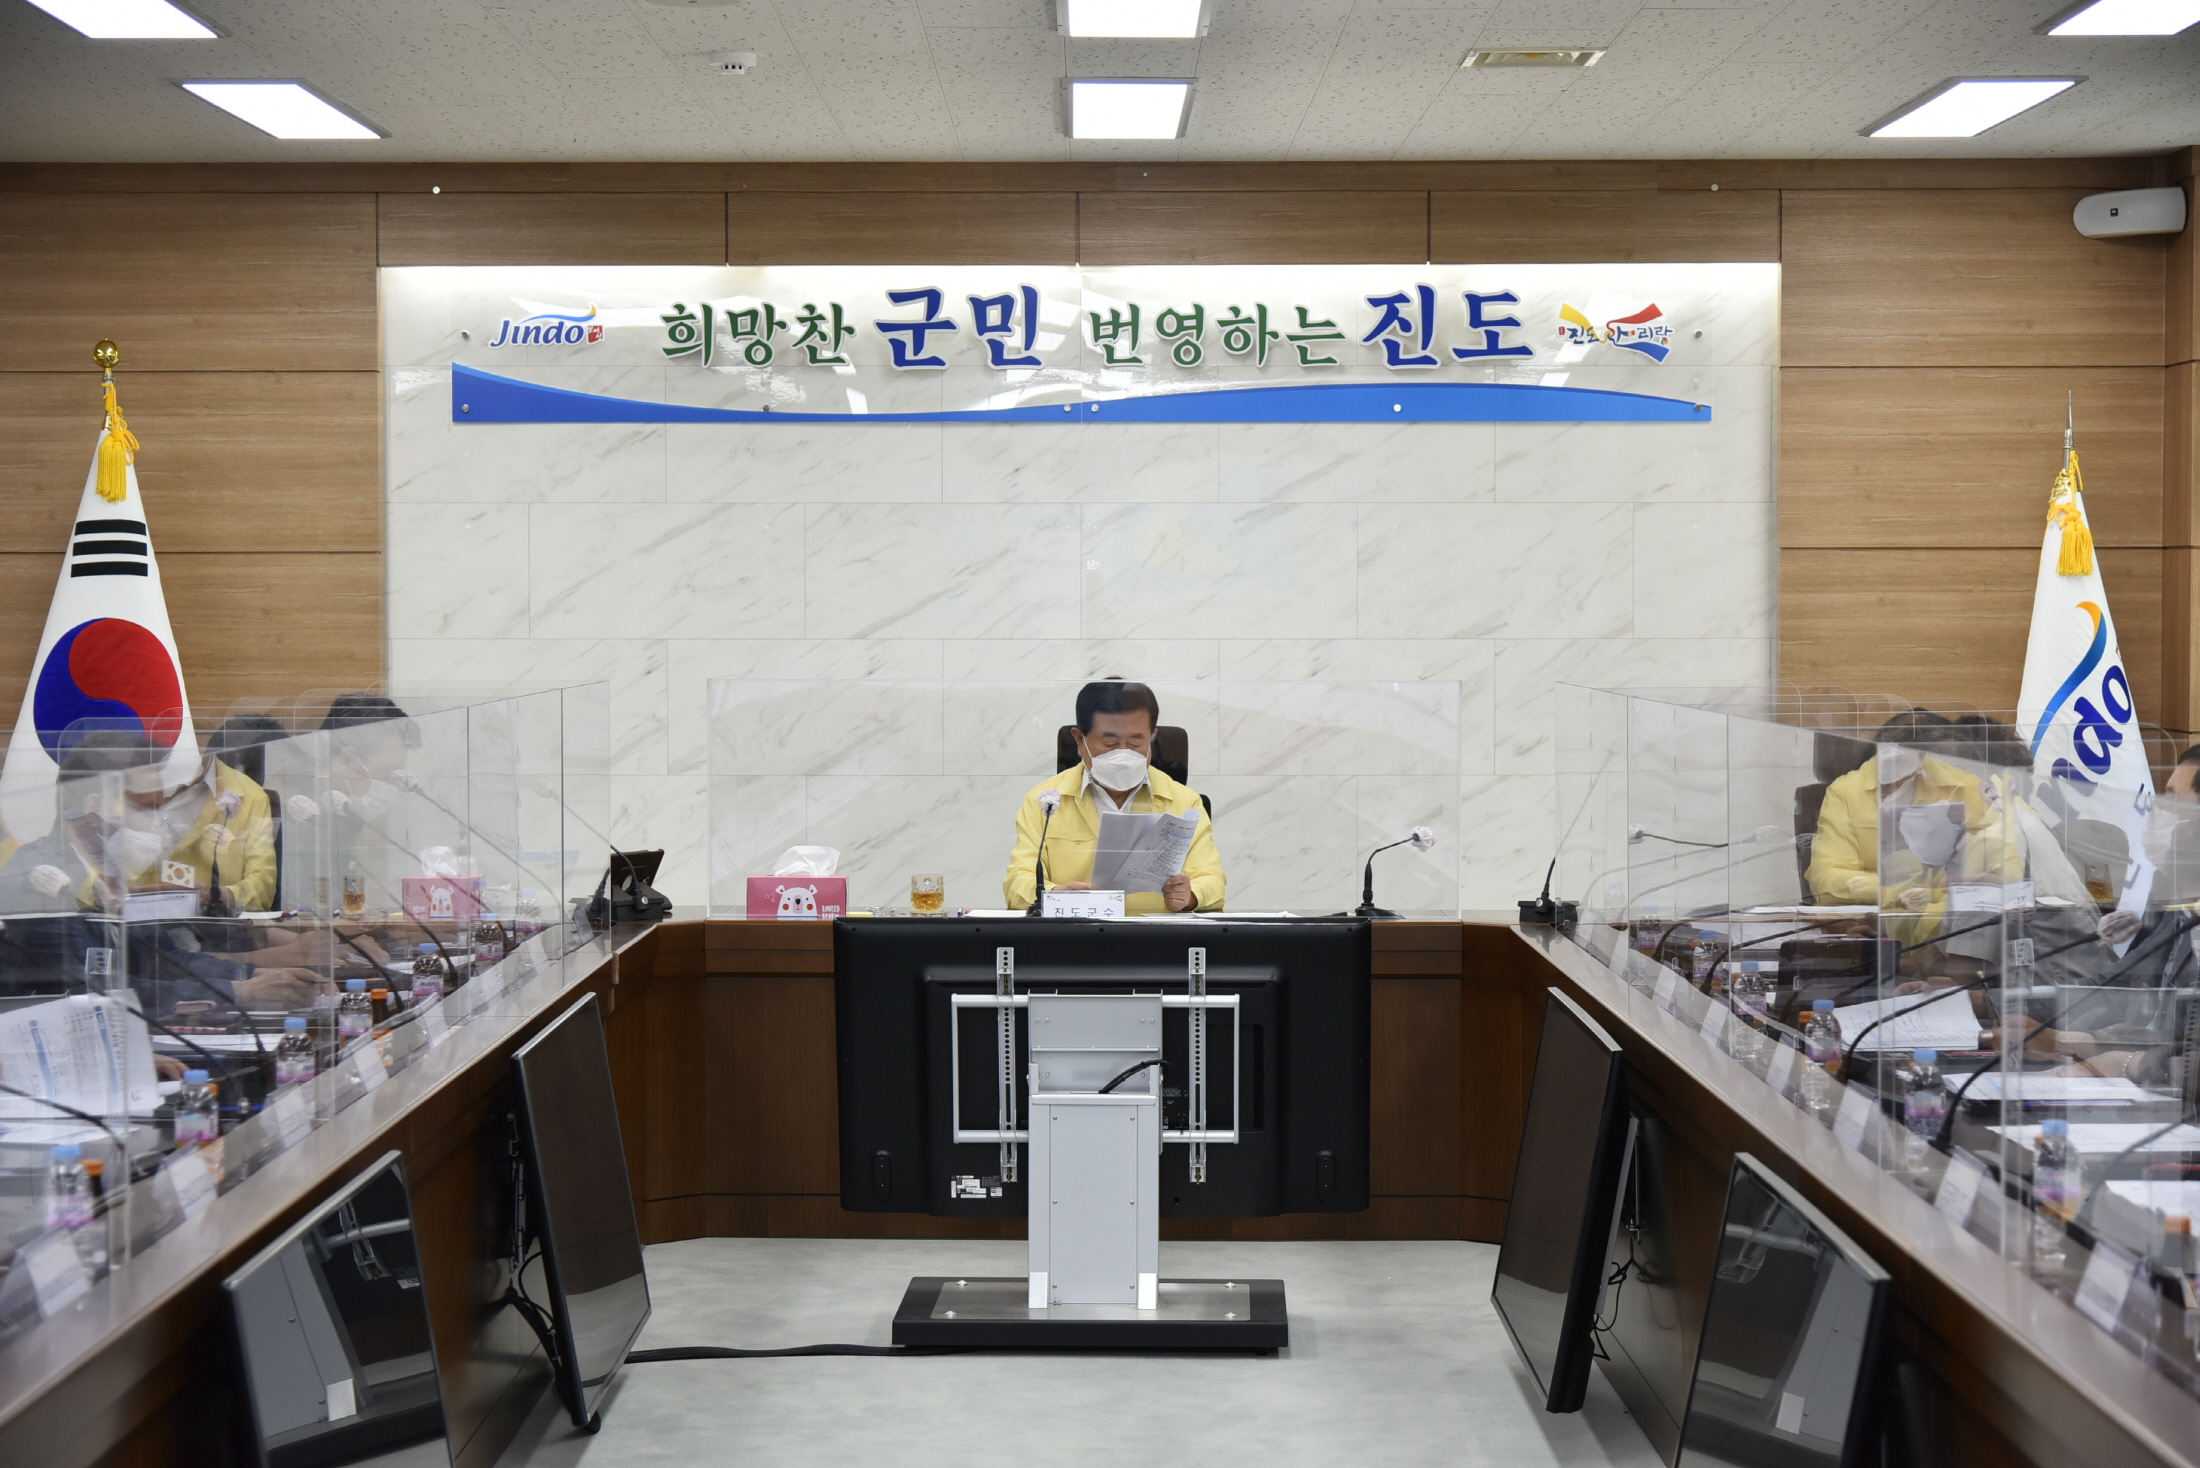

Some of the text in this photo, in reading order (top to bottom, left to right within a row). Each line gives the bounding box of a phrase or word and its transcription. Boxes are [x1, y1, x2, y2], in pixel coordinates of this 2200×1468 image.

[490, 319, 585, 347] Jindo
[661, 284, 1535, 369] 희망찬 군민 번영하는 진도
